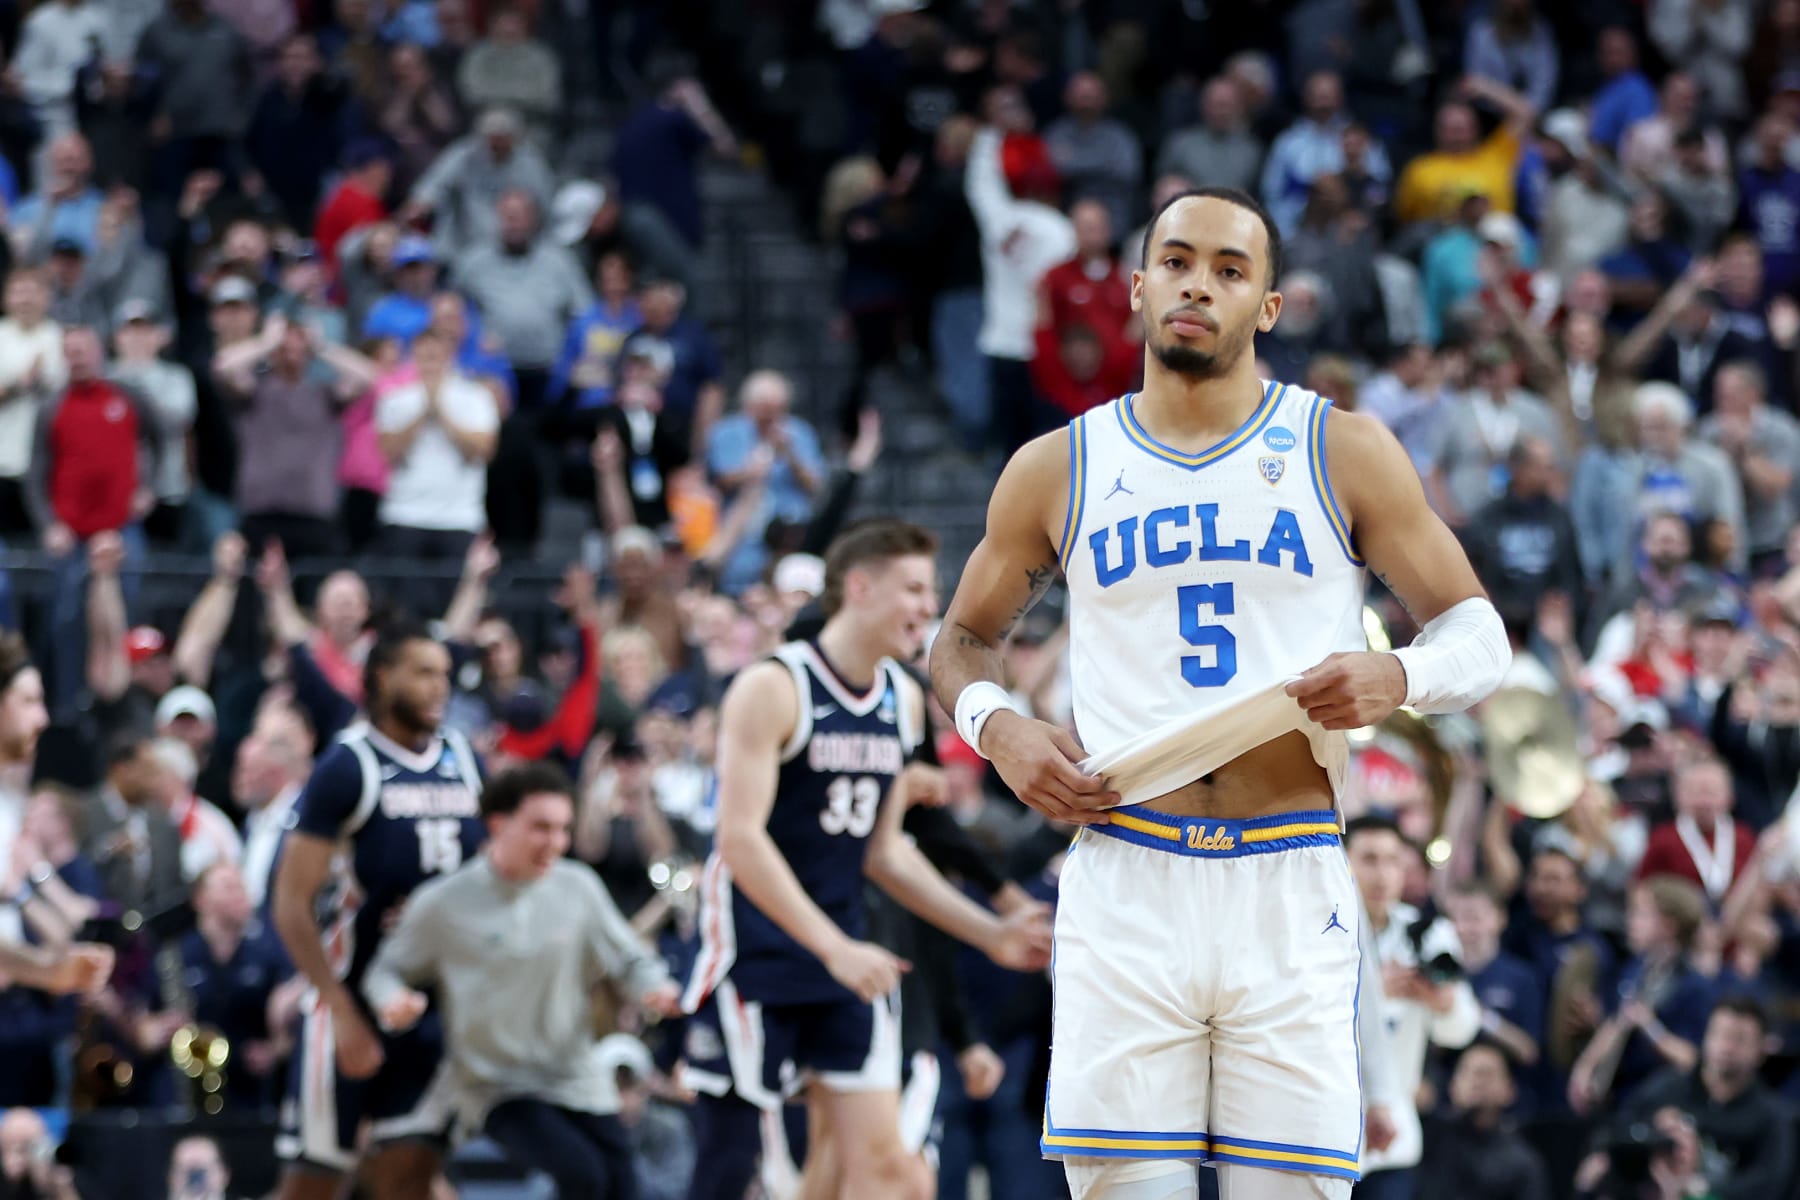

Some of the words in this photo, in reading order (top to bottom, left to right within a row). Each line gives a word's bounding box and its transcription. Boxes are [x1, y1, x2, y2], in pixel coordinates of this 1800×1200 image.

[1268, 436, 1295, 446] NCAA
[1266, 468, 1280, 480] 12
[1089, 503, 1313, 588] UCLA
[1177, 582, 1237, 687] 5
[819, 776, 880, 838] 33
[415, 818, 462, 874] 15
[1186, 825, 1236, 850] Ucla
